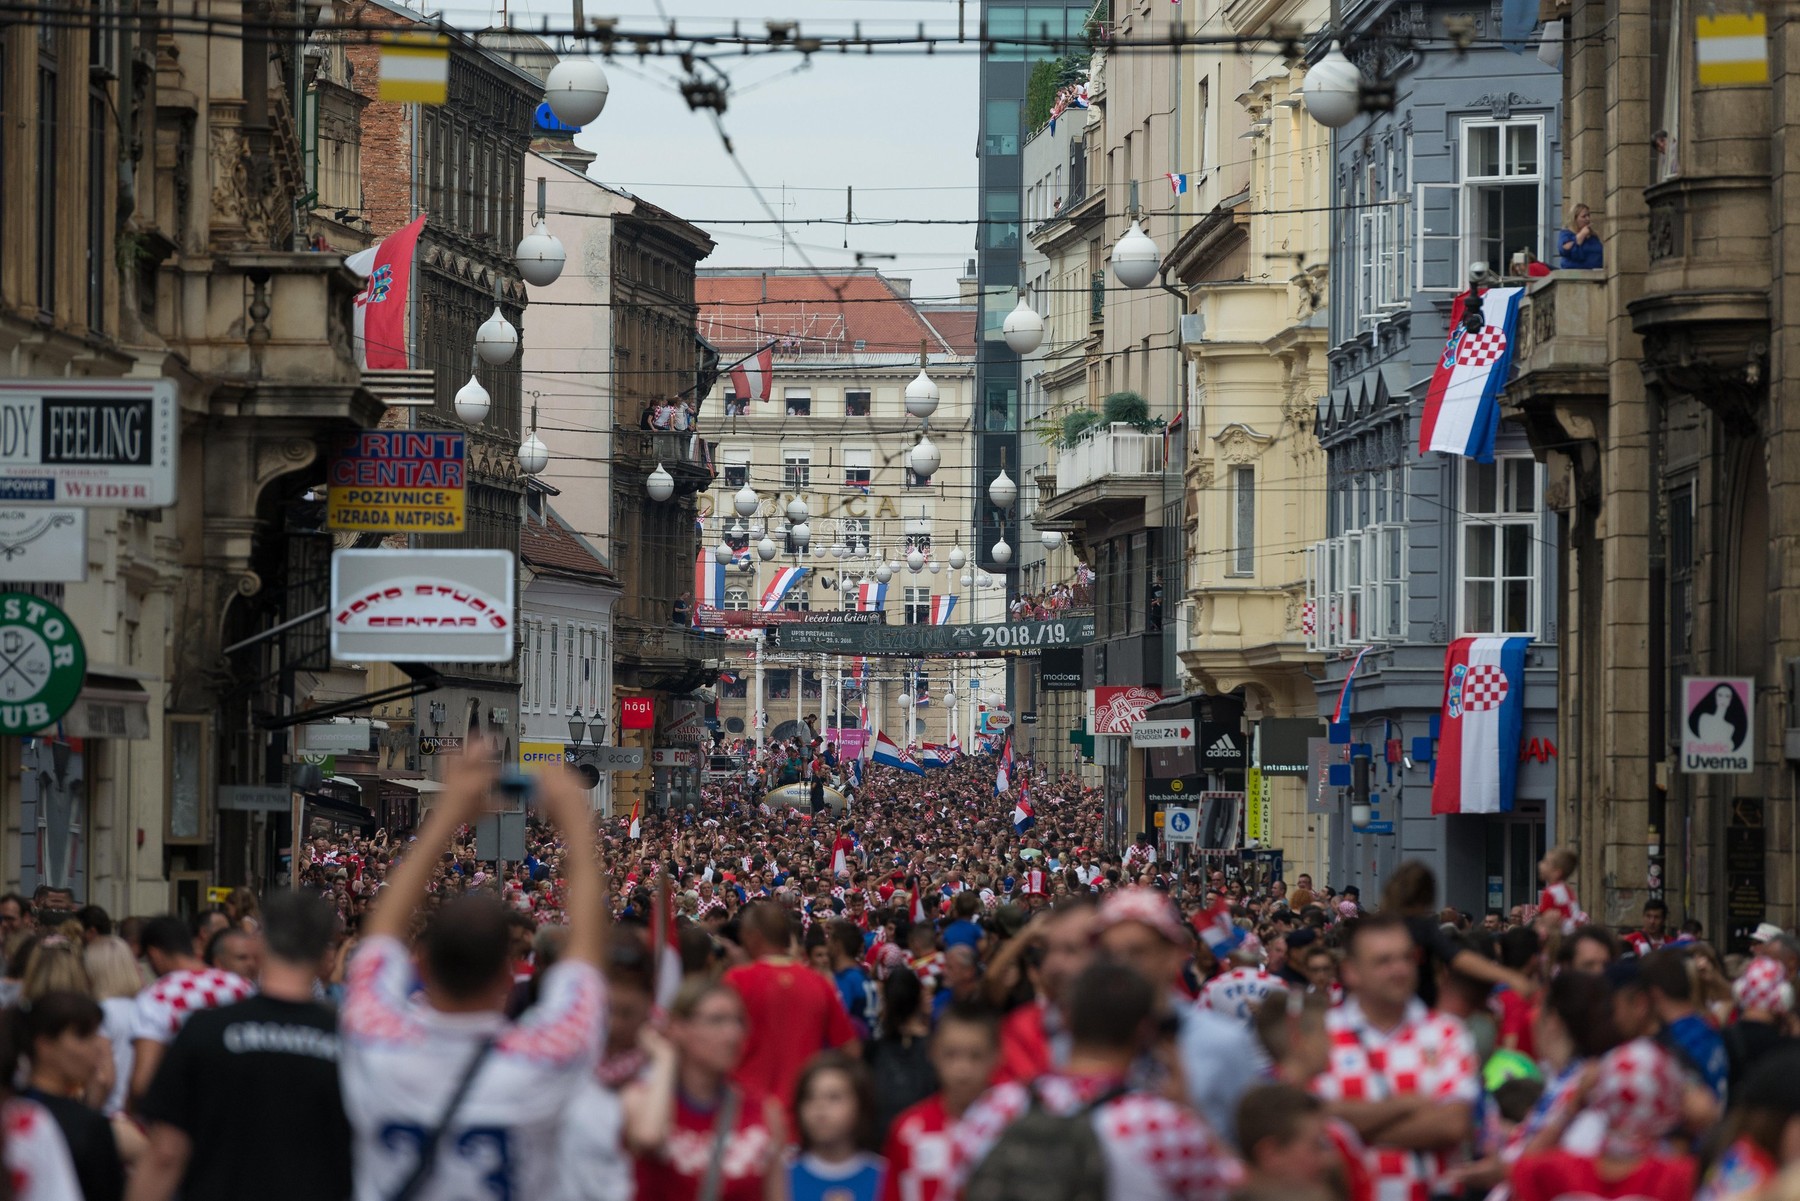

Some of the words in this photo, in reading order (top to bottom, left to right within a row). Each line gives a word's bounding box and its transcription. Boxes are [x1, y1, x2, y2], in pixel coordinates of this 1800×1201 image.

[0, 405, 35, 458] DY
[48, 405, 142, 461] FEELING
[339, 433, 464, 458] PRINT
[333, 460, 463, 487] CENTAR
[65, 483, 146, 498] WEIDER
[349, 490, 445, 505] POZIVNICE
[337, 509, 390, 524] IZRADA
[394, 510, 455, 526] NATPISA
[336, 587, 402, 625] FOTO
[414, 585, 507, 629] STUDIO
[368, 616, 477, 627] CENTAR
[0, 598, 75, 669] STOR
[863, 627, 948, 649] SEZONA
[1043, 673, 1080, 681] modoars
[0, 702, 50, 729] UB
[676, 725, 701, 735] SALON
[423, 738, 459, 748] VINCEK
[523, 753, 562, 762] OFFICE
[608, 754, 640, 764] ecco
[1206, 748, 1241, 758] adidas
[1262, 775, 1270, 843] MJENJAČNICA
